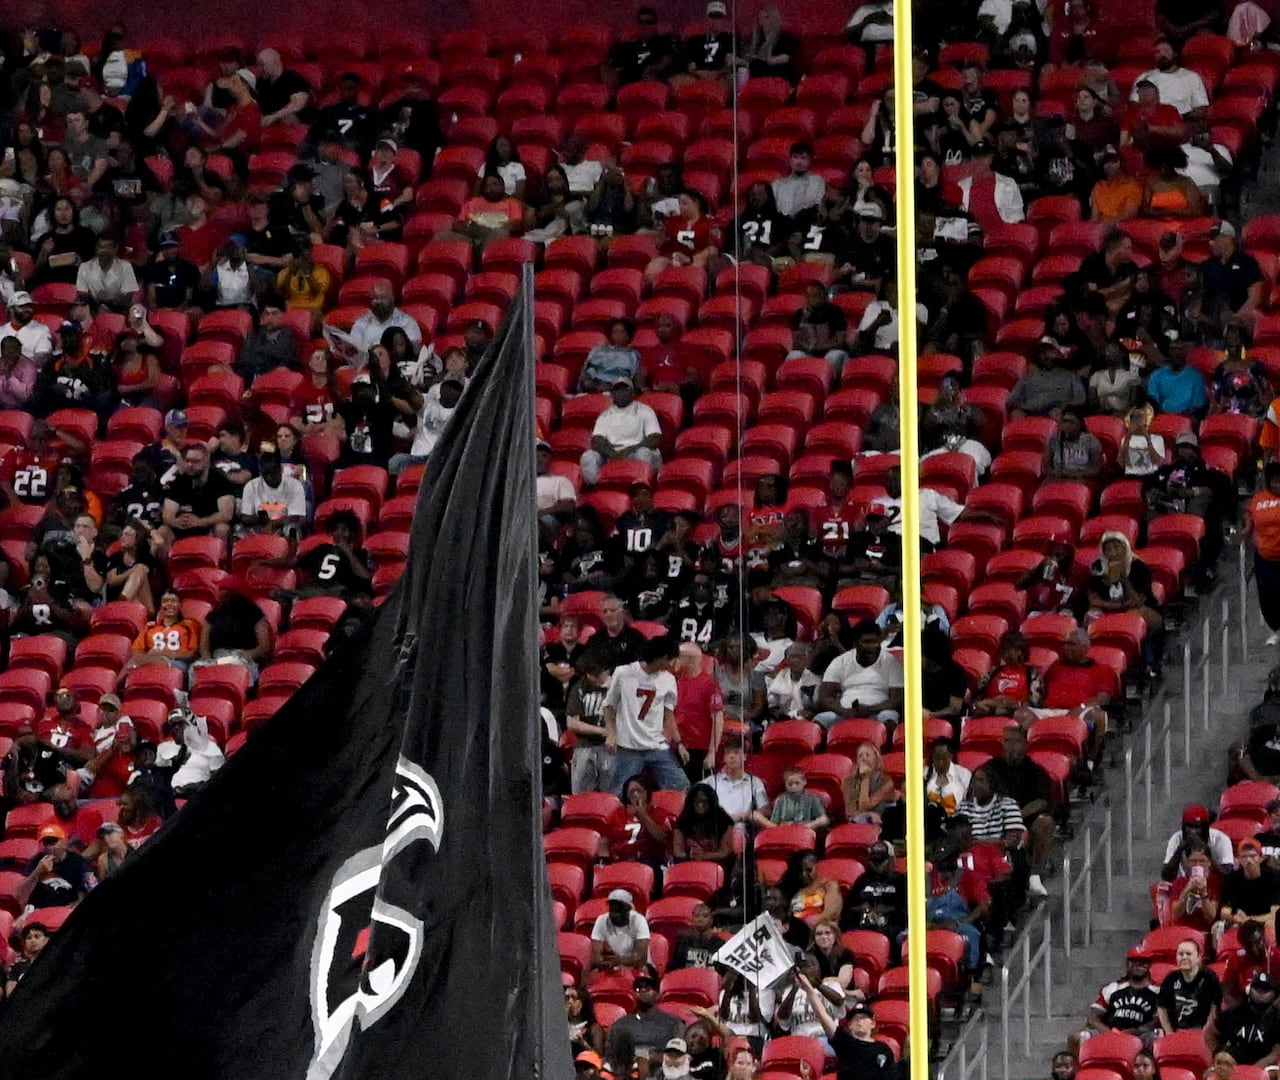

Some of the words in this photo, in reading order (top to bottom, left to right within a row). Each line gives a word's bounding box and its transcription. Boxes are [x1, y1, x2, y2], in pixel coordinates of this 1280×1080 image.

[338, 118, 354, 135] 7
[14, 468, 49, 497] 22
[626, 528, 652, 552] 10
[822, 521, 850, 540] 21
[319, 553, 341, 580] 5
[668, 555, 684, 578] 8
[1055, 583, 1074, 606] 7
[152, 629, 182, 652] 88
[680, 618, 714, 645] 84
[636, 688, 658, 722] 7
[624, 822, 642, 845] 7
[1236, 1024, 1265, 1045] A/X
